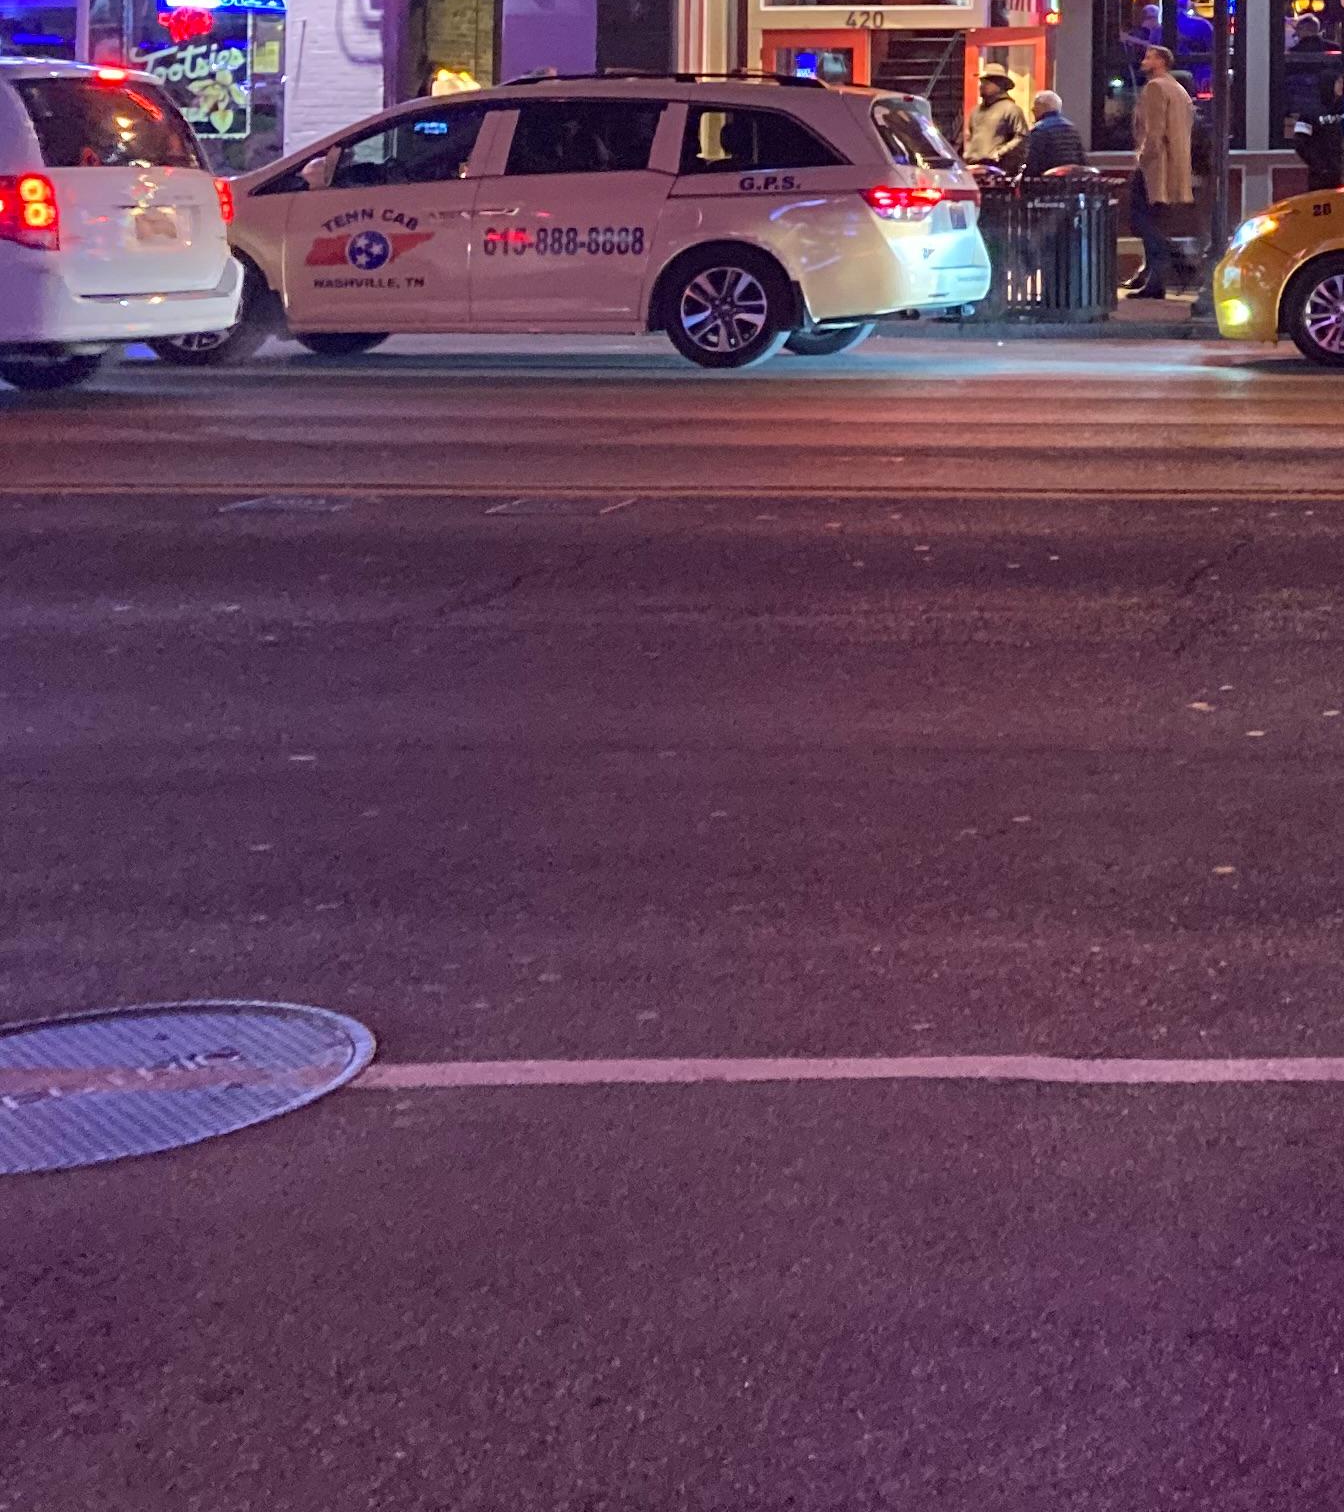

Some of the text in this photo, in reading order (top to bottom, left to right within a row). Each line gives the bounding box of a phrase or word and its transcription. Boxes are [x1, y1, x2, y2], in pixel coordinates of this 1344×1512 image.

[845, 10, 885, 28] 420
[738, 175, 801, 191] G.P.S.
[321, 208, 419, 233] TENN CAB
[405, 276, 425, 288] TN
